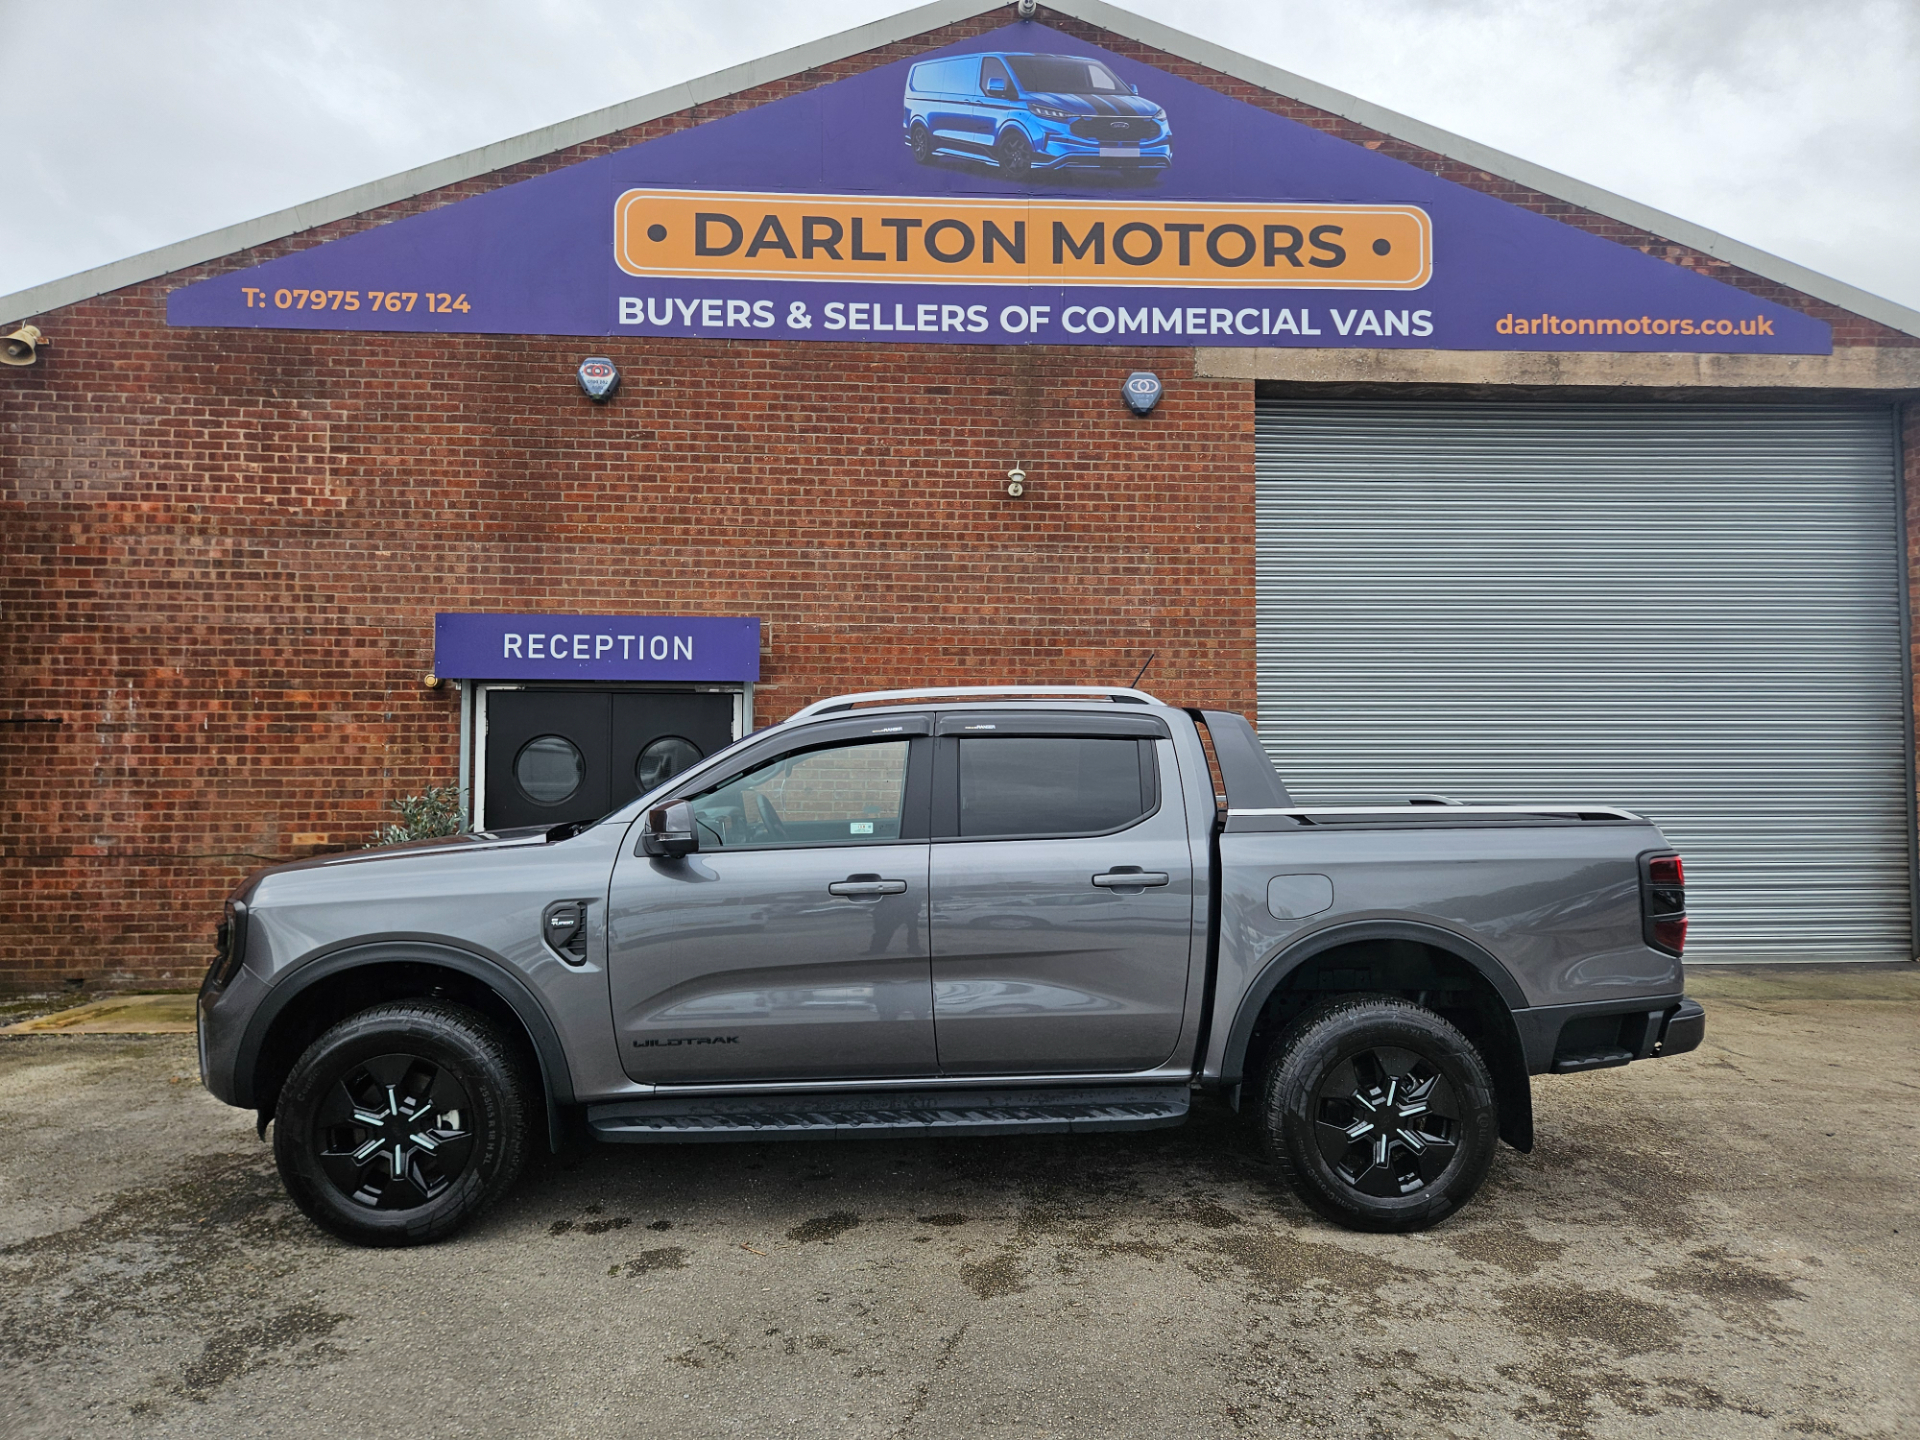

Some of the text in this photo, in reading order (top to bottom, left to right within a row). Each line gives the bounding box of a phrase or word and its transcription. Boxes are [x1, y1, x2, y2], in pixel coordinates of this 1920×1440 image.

[695, 212, 1347, 269] DARLTON MOTORS
[242, 287, 471, 313] T: 07975 767 124
[618, 296, 1434, 337] BUYERS & SELLERS OF COMMERCIAL VANS
[1496, 314, 1775, 336] darltonmotors.co.uk
[503, 633, 693, 661] RECEPTION
[633, 1036, 739, 1048] WILDTRAK
